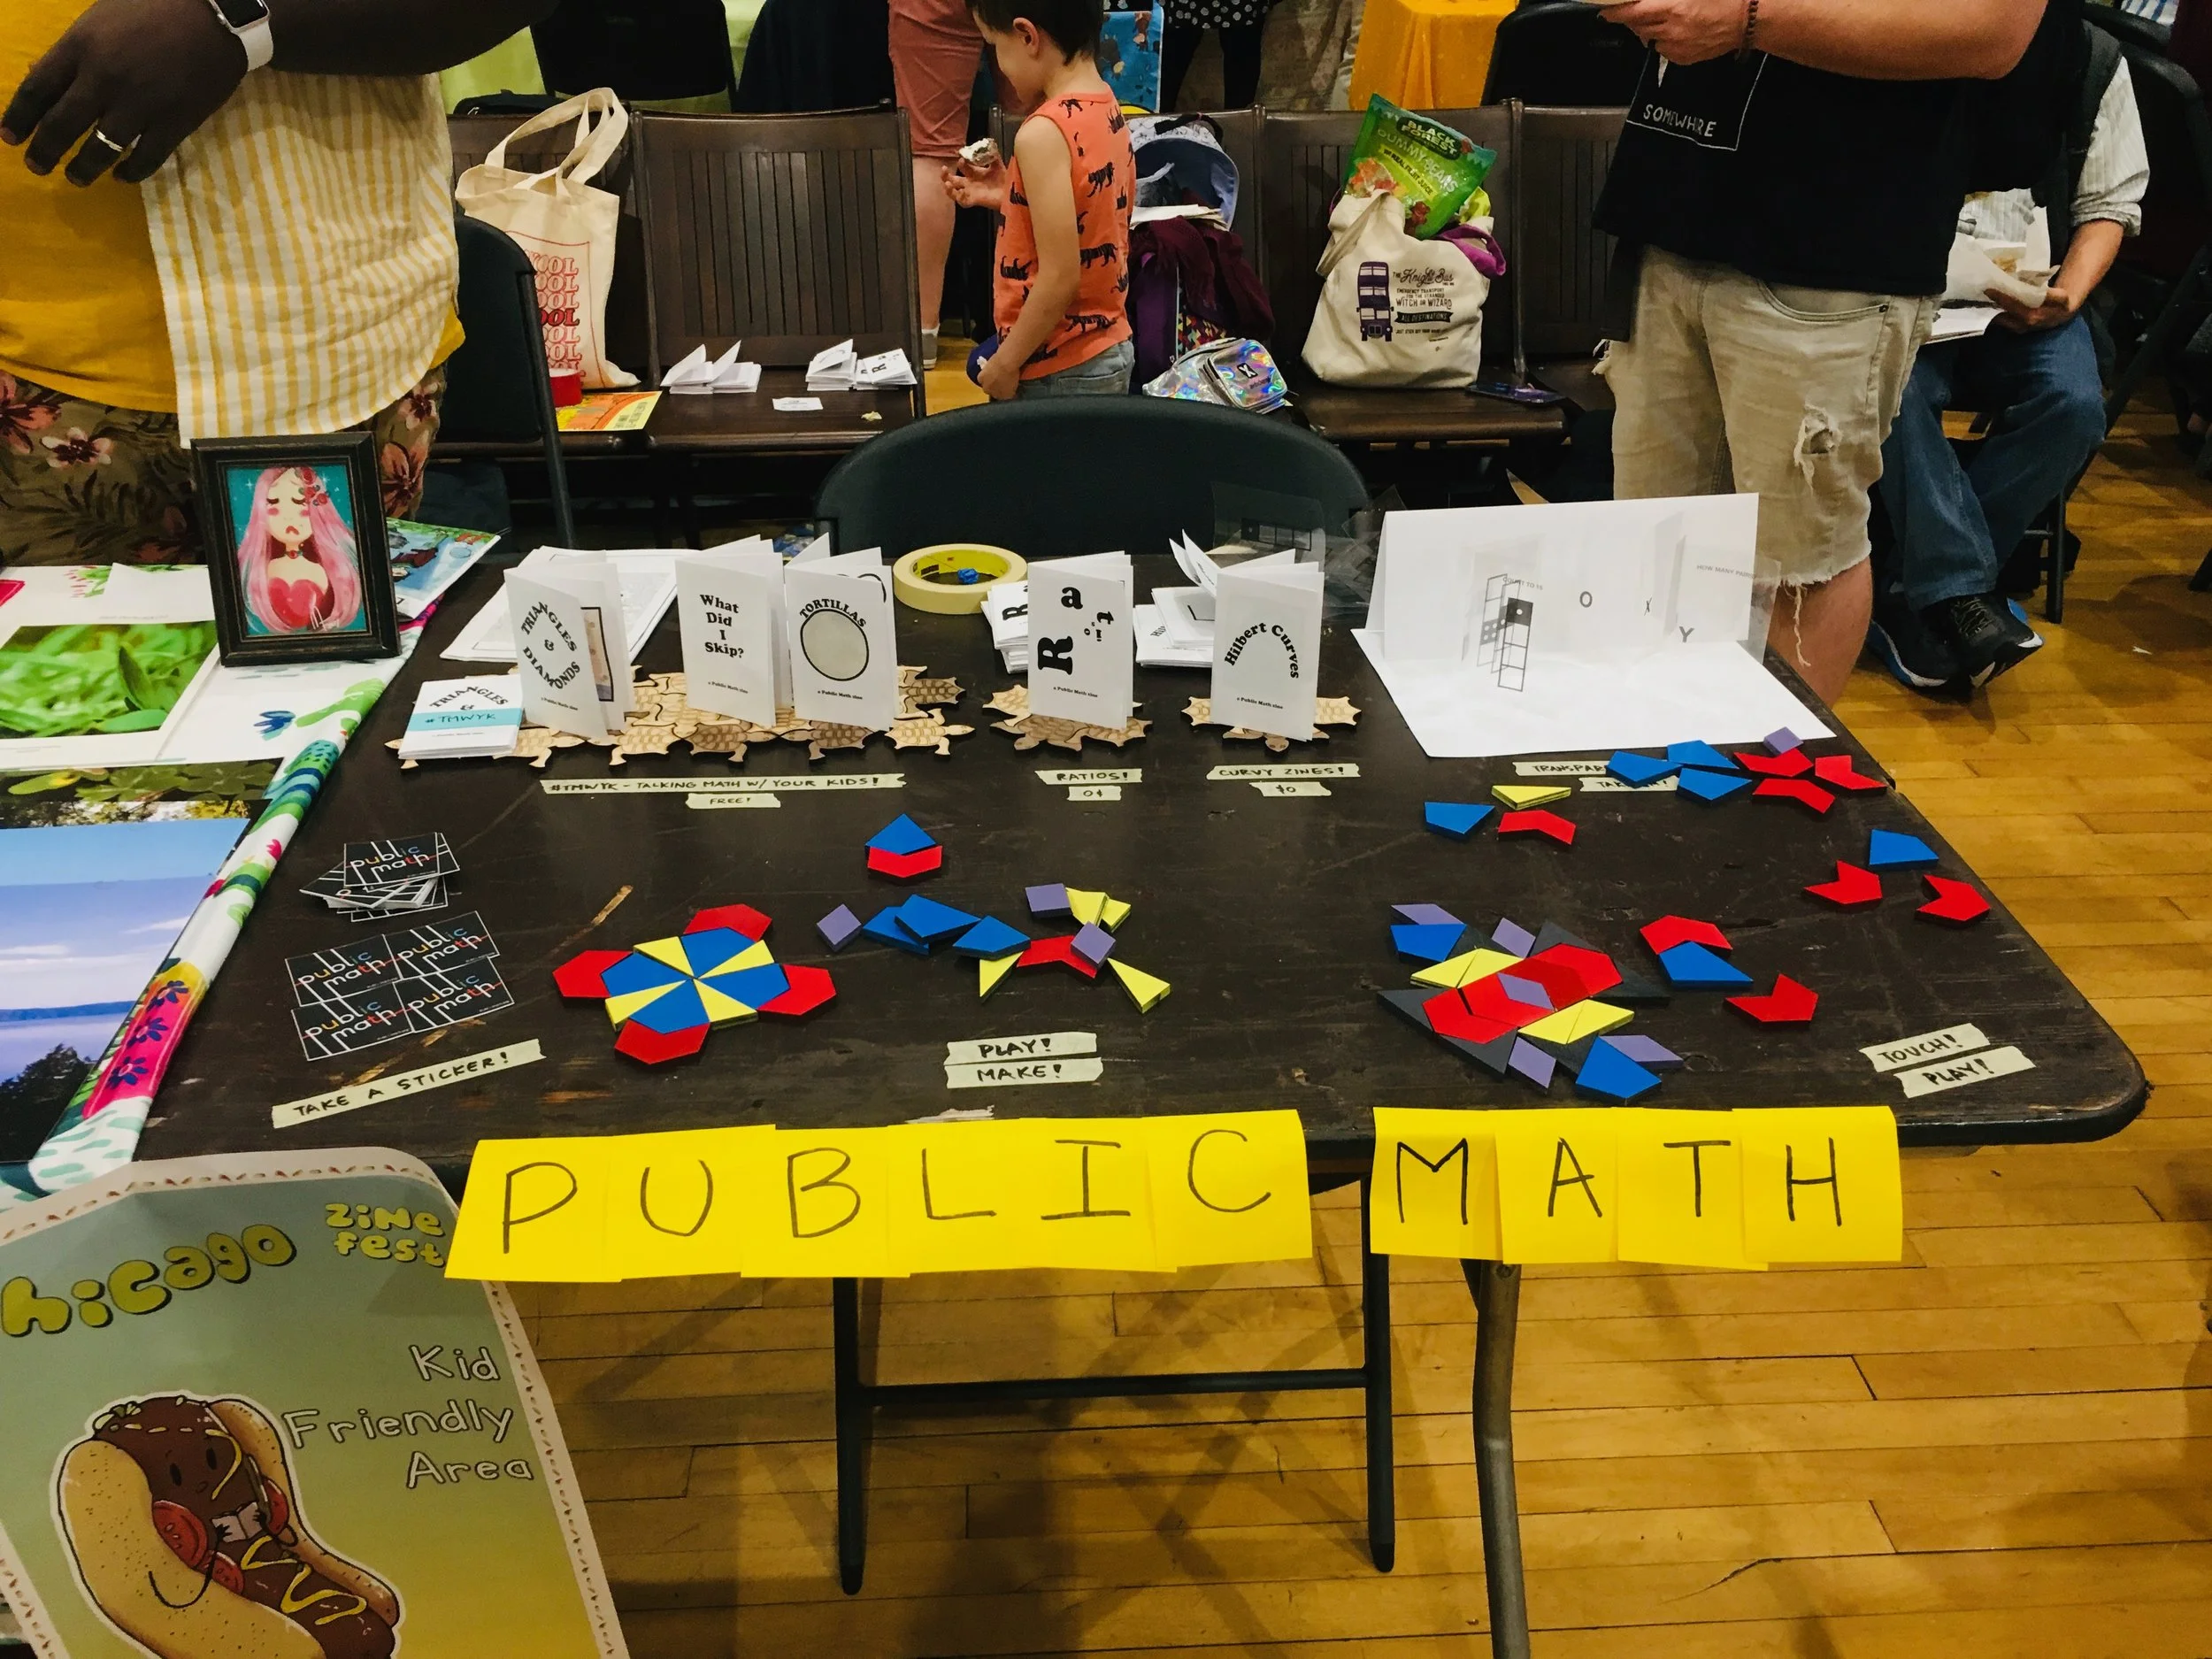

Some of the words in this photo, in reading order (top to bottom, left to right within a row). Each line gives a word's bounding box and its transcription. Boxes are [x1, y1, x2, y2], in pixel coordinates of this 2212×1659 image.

[1402, 125, 1457, 155] FOREST
[1408, 120, 1455, 147] BLACK
[1400, 267, 1435, 288] Knight
[1395, 296, 1418, 307] WITCH
[1427, 298, 1452, 310] WIZARD
[700, 595, 739, 613] What
[800, 598, 866, 628] TORTILLAS
[521, 602, 577, 652] TRIANGLES
[706, 612, 733, 627] Did
[544, 639, 554, 651] &
[719, 630, 726, 641] I
[1679, 626, 1694, 643] Y
[704, 642, 743, 658] Skip?
[1224, 622, 1267, 666] Hilbert
[1271, 625, 1299, 679] Curves
[523, 647, 580, 689] DIAMONDS
[429, 686, 509, 708] TRIANGLES
[425, 713, 496, 723] #TMWYK
[1056, 771, 1128, 782] RATIOS!
[1218, 767, 1273, 778] CURVY
[1283, 765, 1345, 776] ZINES!
[549, 781, 618, 792] #TMWYK
[637, 781, 697, 790] TALKING
[703, 780, 741, 789] MATH
[747, 778, 767, 791] W/
[772, 779, 816, 788] YOUR
[826, 776, 879, 787] KIDS!
[709, 797, 752, 806] FREE!
[978, 1037, 1051, 1059] PLAY!
[1878, 1033, 1963, 1064] TOUCH!
[977, 1064, 1062, 1082] MAKE!
[1922, 1058, 1994, 1086] PLAY!
[293, 1094, 349, 1117] TAKE
[368, 1087, 384, 1100] A
[396, 1051, 509, 1090] STICKER!
[502, 1128, 1271, 1254] PUBLIC
[1397, 1136, 1842, 1226] MATH
[334, 1231, 446, 1268] fest
[410, 1344, 500, 1381] Kid
[281, 1399, 513, 1449] Friendly
[406, 1451, 534, 1489] Area
